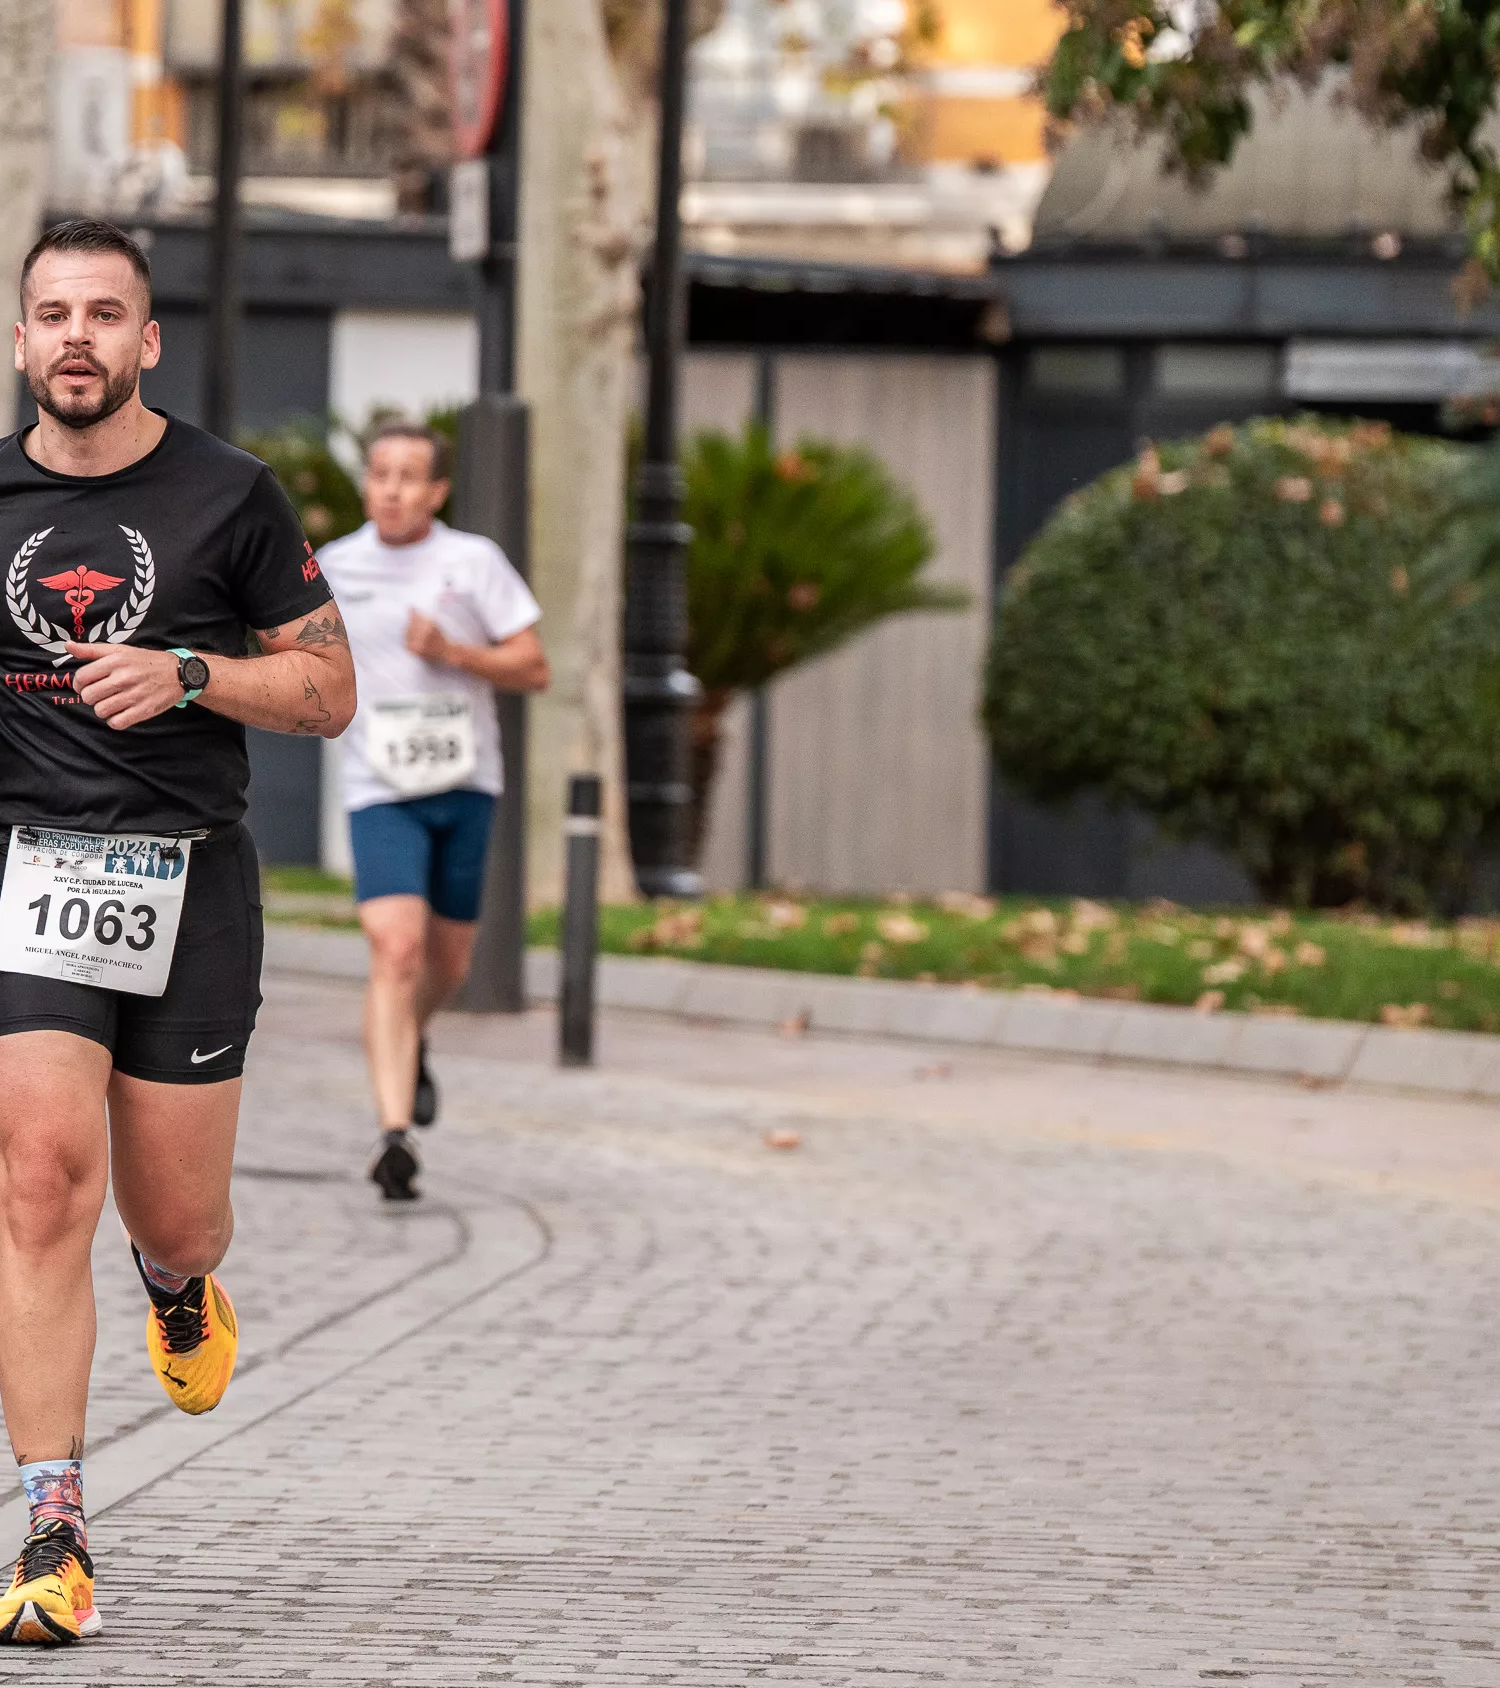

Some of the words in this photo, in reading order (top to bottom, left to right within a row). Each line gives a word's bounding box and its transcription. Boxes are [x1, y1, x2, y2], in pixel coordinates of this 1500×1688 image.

[4, 671, 73, 693] HERM
[52, 694, 82, 705] Trai
[52, 832, 94, 845] PROVINCIAL
[95, 837, 106, 846] DE
[60, 840, 105, 853] POPULARES
[104, 839, 151, 858] 2024
[53, 875, 70, 883] XXV
[69, 877, 82, 885] C.P.
[82, 878, 107, 886] CIUDAD
[107, 879, 117, 887] DE
[117, 879, 144, 889] LUCENA
[67, 886, 81, 894] POR
[92, 888, 126, 896] IGUALDAD
[28, 893, 157, 952] 1063
[25, 946, 54, 955] MIGUEL
[55, 950, 80, 960] ANGEL
[81, 954, 108, 965] PAREJO
[109, 957, 143, 971] PACHECO
